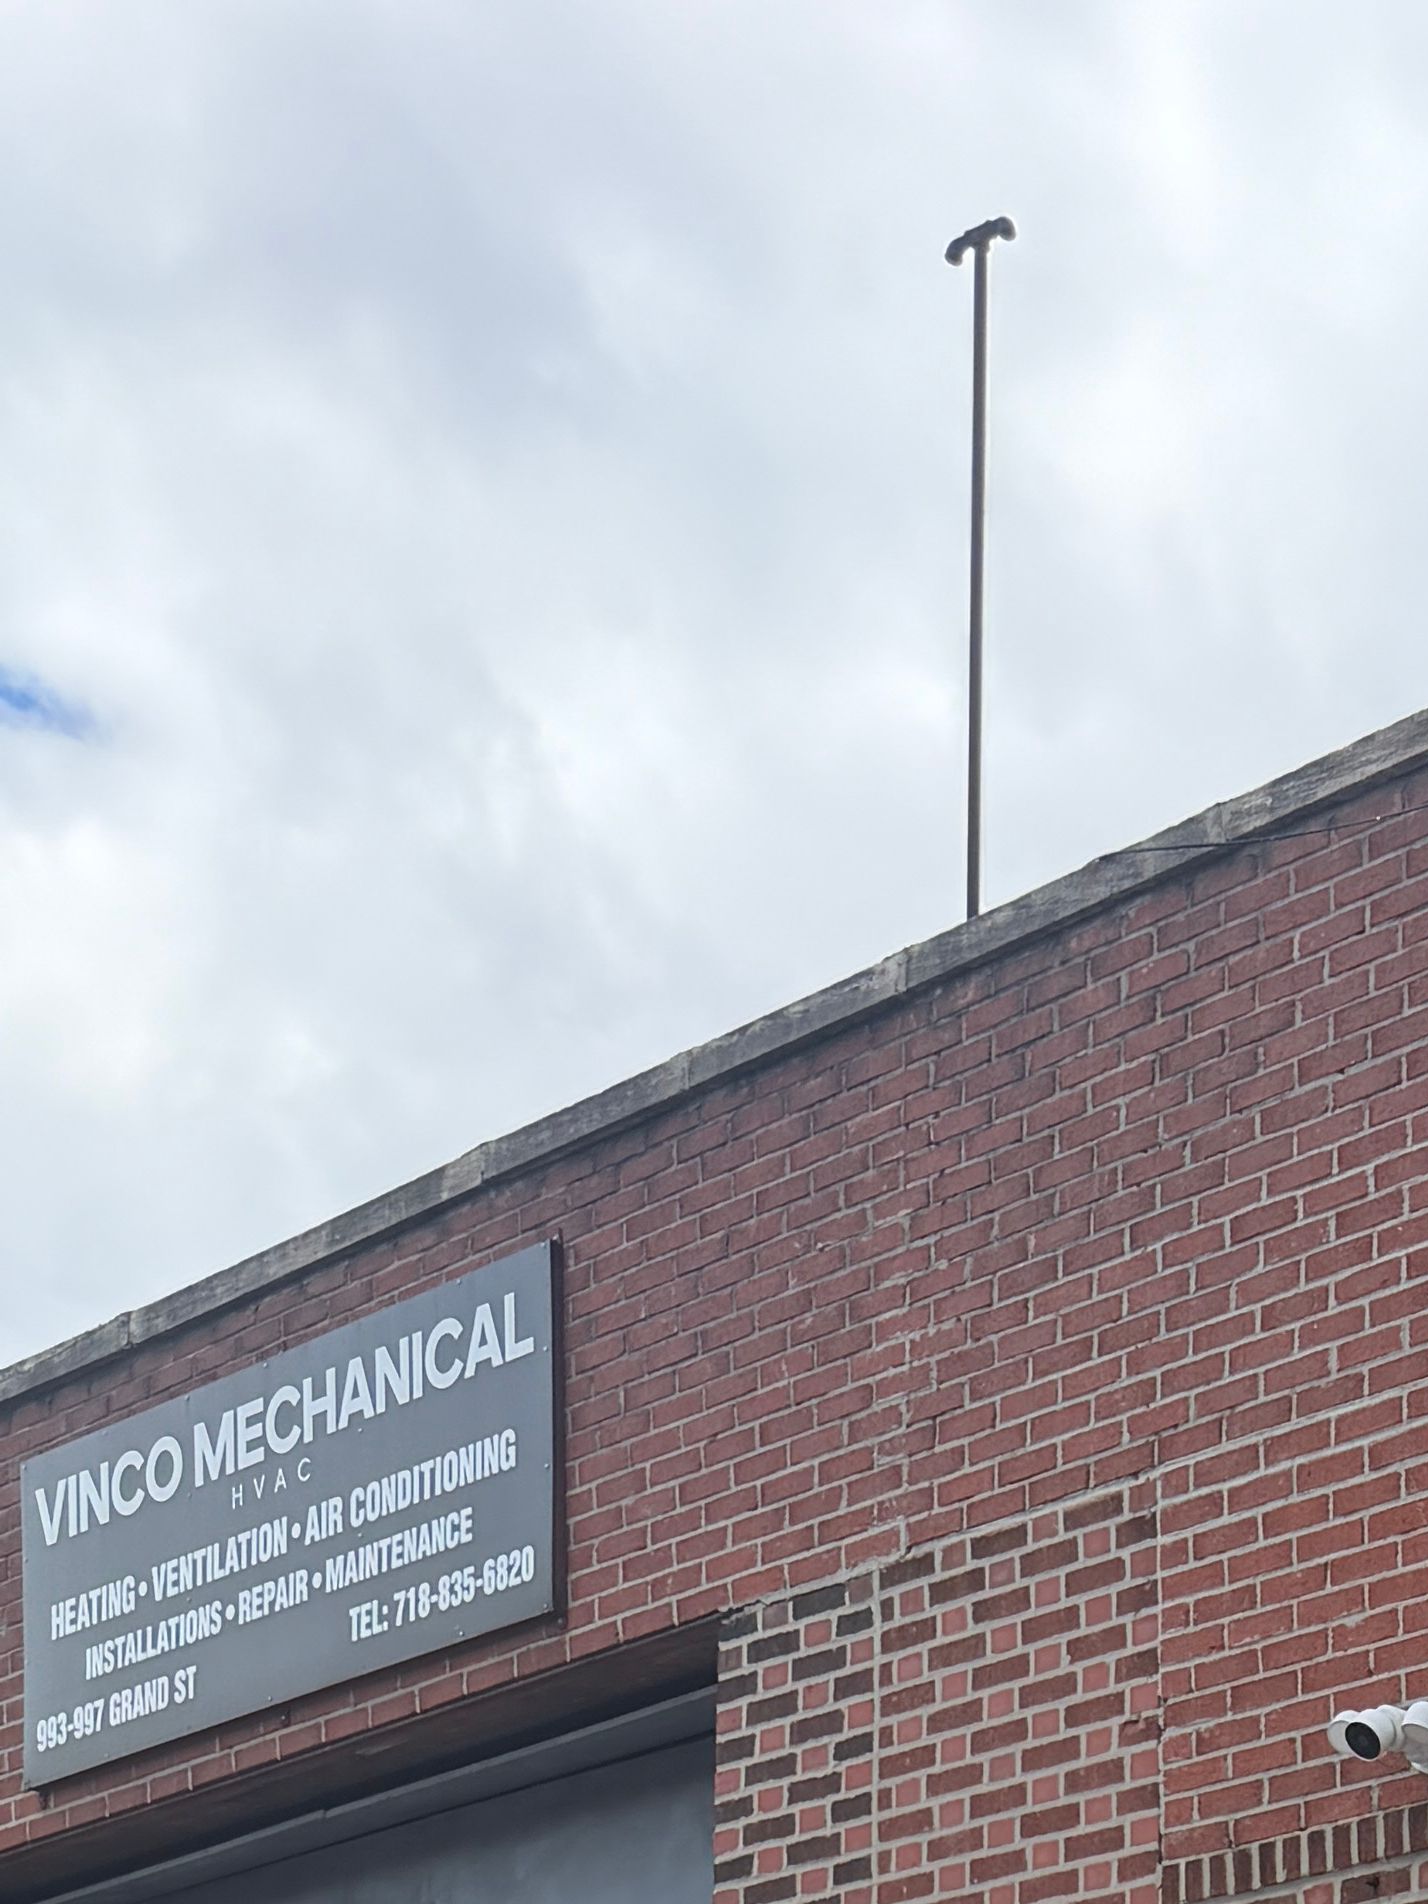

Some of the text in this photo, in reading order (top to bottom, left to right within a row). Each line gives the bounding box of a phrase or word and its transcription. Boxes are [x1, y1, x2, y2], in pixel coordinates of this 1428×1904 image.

[35, 1292, 535, 1546] VINCO MECHANICAL
[50, 1429, 516, 1640] HEATING VENTILATION AIR CONDITIONING
[85, 1507, 473, 1680] INSTALLATIONS REPAIR MAINTENANCE
[349, 1545, 535, 1643] TEL: 718-835-6820
[37, 1665, 197, 1753] 993-997 GRAND ST
